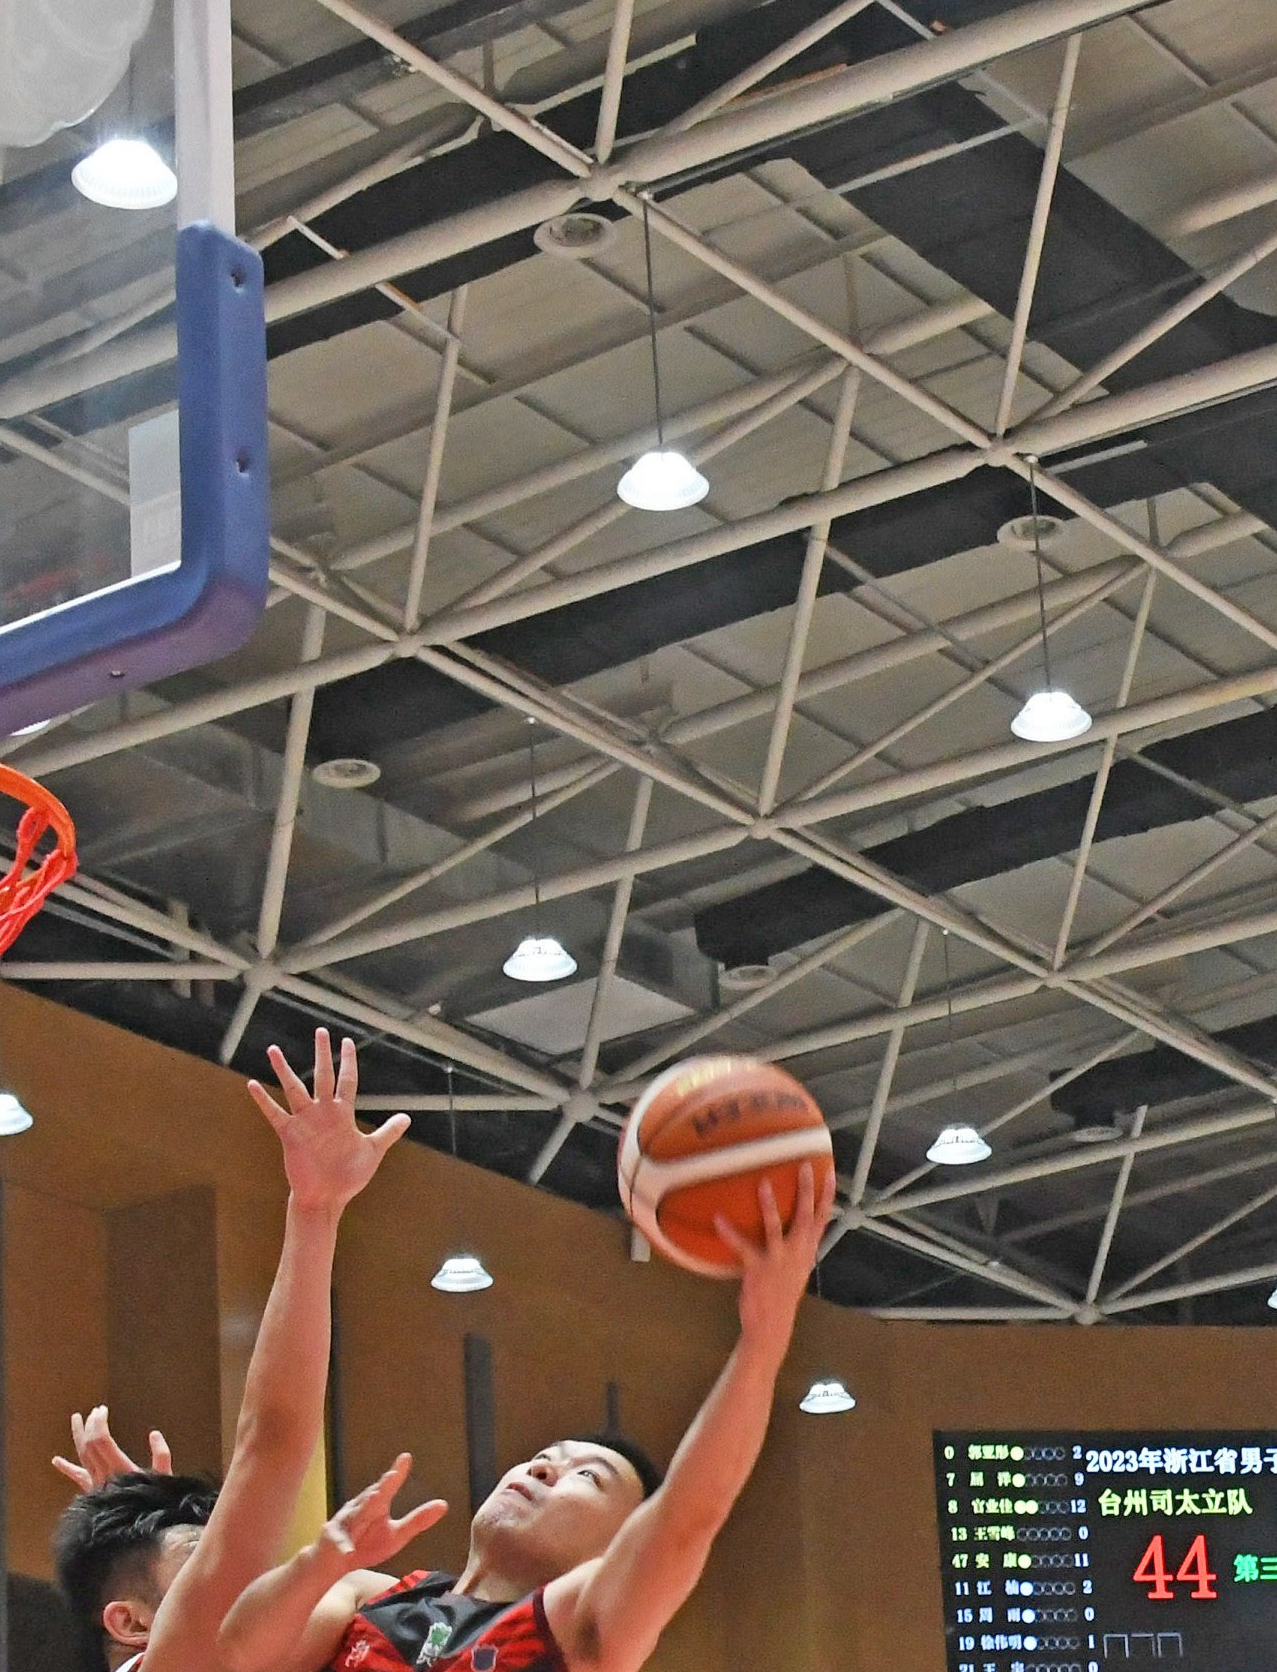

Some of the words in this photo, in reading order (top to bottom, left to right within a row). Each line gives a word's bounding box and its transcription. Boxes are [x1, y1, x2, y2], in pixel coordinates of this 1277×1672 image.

[945, 1446, 954, 1459] 0
[1073, 1445, 1082, 1459] 2
[947, 1473, 955, 1486] 7
[1075, 1472, 1084, 1486] 9
[948, 1500, 957, 1513] 8
[1071, 1499, 1086, 1513] 12
[1098, 1488, 1252, 1516] 台州司太立队
[952, 1528, 967, 1541] 13
[1079, 1526, 1088, 1539] 0
[952, 1554, 968, 1568] 47
[1075, 1553, 1089, 1567] 11
[1133, 1535, 1217, 1599] 44
[1234, 1554, 1277, 1582] 第三
[955, 1582, 969, 1595] 11
[1083, 1580, 1092, 1593] 2
[1085, 1607, 1094, 1621] 0
[959, 1637, 974, 1650] 19
[1089, 1635, 1094, 1648] 1
